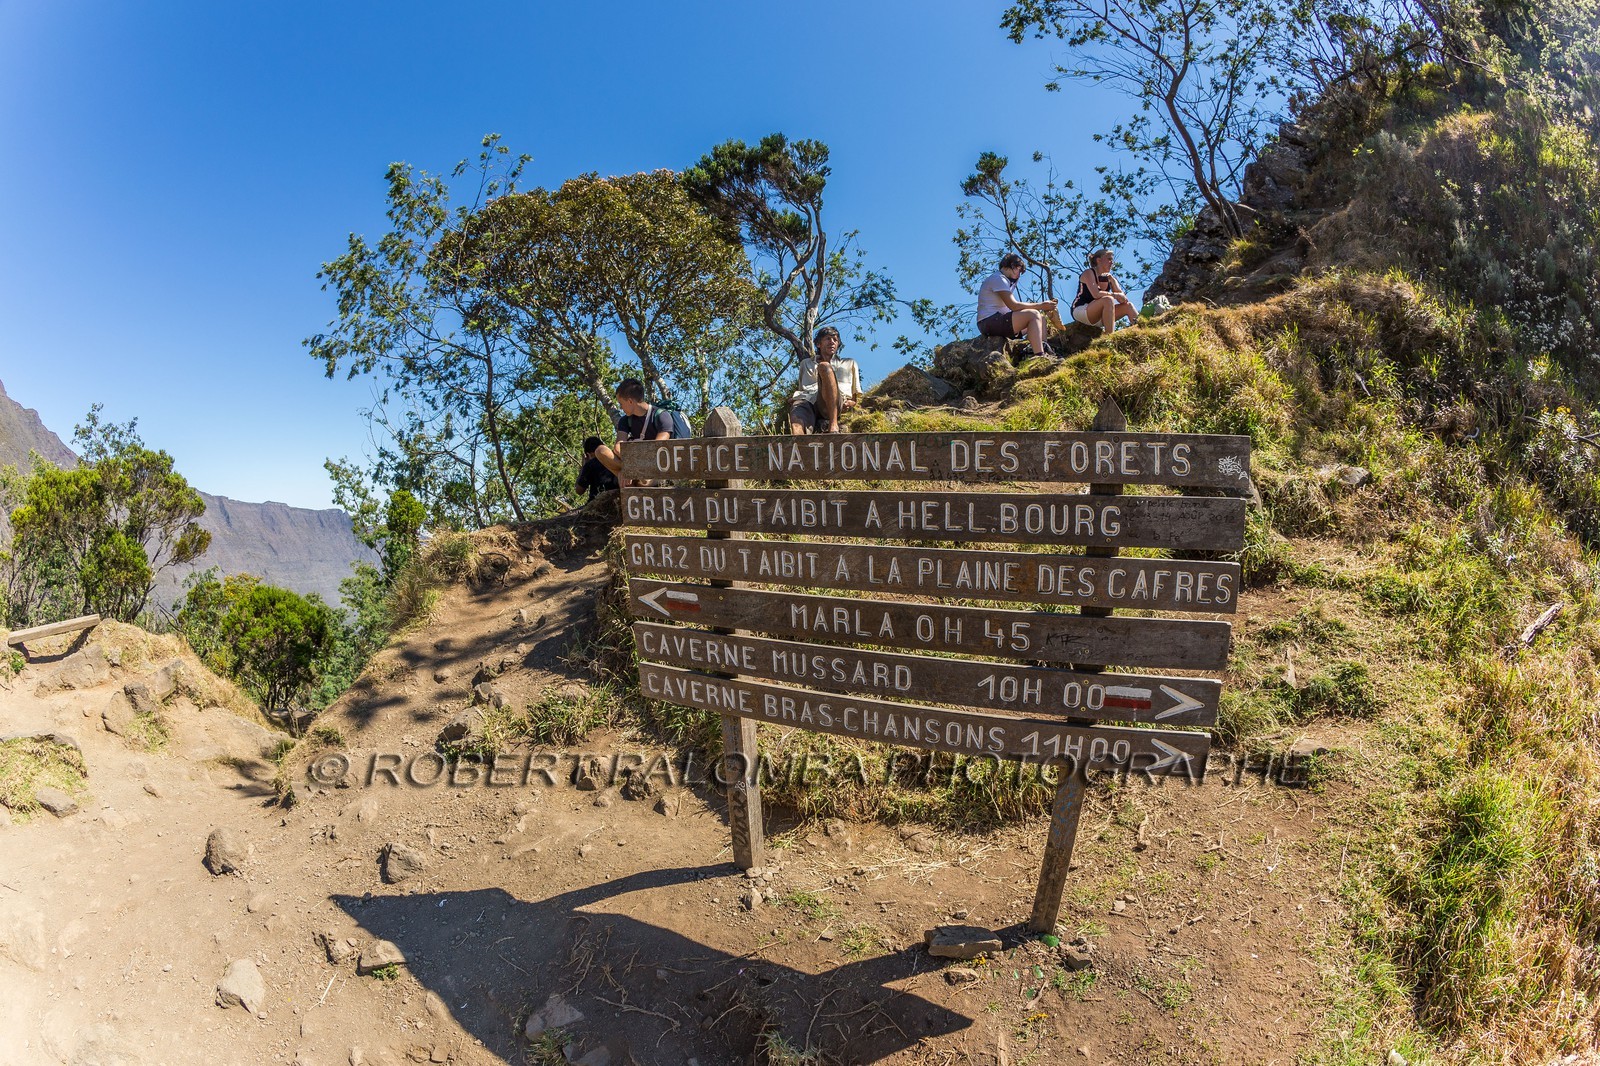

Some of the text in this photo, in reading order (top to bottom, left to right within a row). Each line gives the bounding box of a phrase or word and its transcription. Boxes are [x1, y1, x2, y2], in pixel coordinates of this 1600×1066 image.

[656, 443, 750, 472] OFFICE
[767, 440, 929, 472] NATIONAL
[951, 439, 1019, 473] DES
[1044, 440, 1191, 477] FORETS
[706, 497, 738, 524] DU
[752, 498, 848, 528] TAIBIT
[865, 500, 883, 529] A
[699, 546, 726, 572] DU
[738, 548, 819, 579] TAIBIT
[835, 554, 850, 582] A
[868, 555, 902, 585] LA
[918, 557, 1020, 593] PLAINE
[1037, 564, 1096, 597] DES
[1107, 568, 1233, 605] CAFRES
[791, 603, 895, 639] MARLA
[984, 619, 1031, 651] 45
[643, 631, 757, 671] CAVERNE
[772, 650, 912, 691] MUSSARD
[647, 672, 753, 713] CAVERNE
